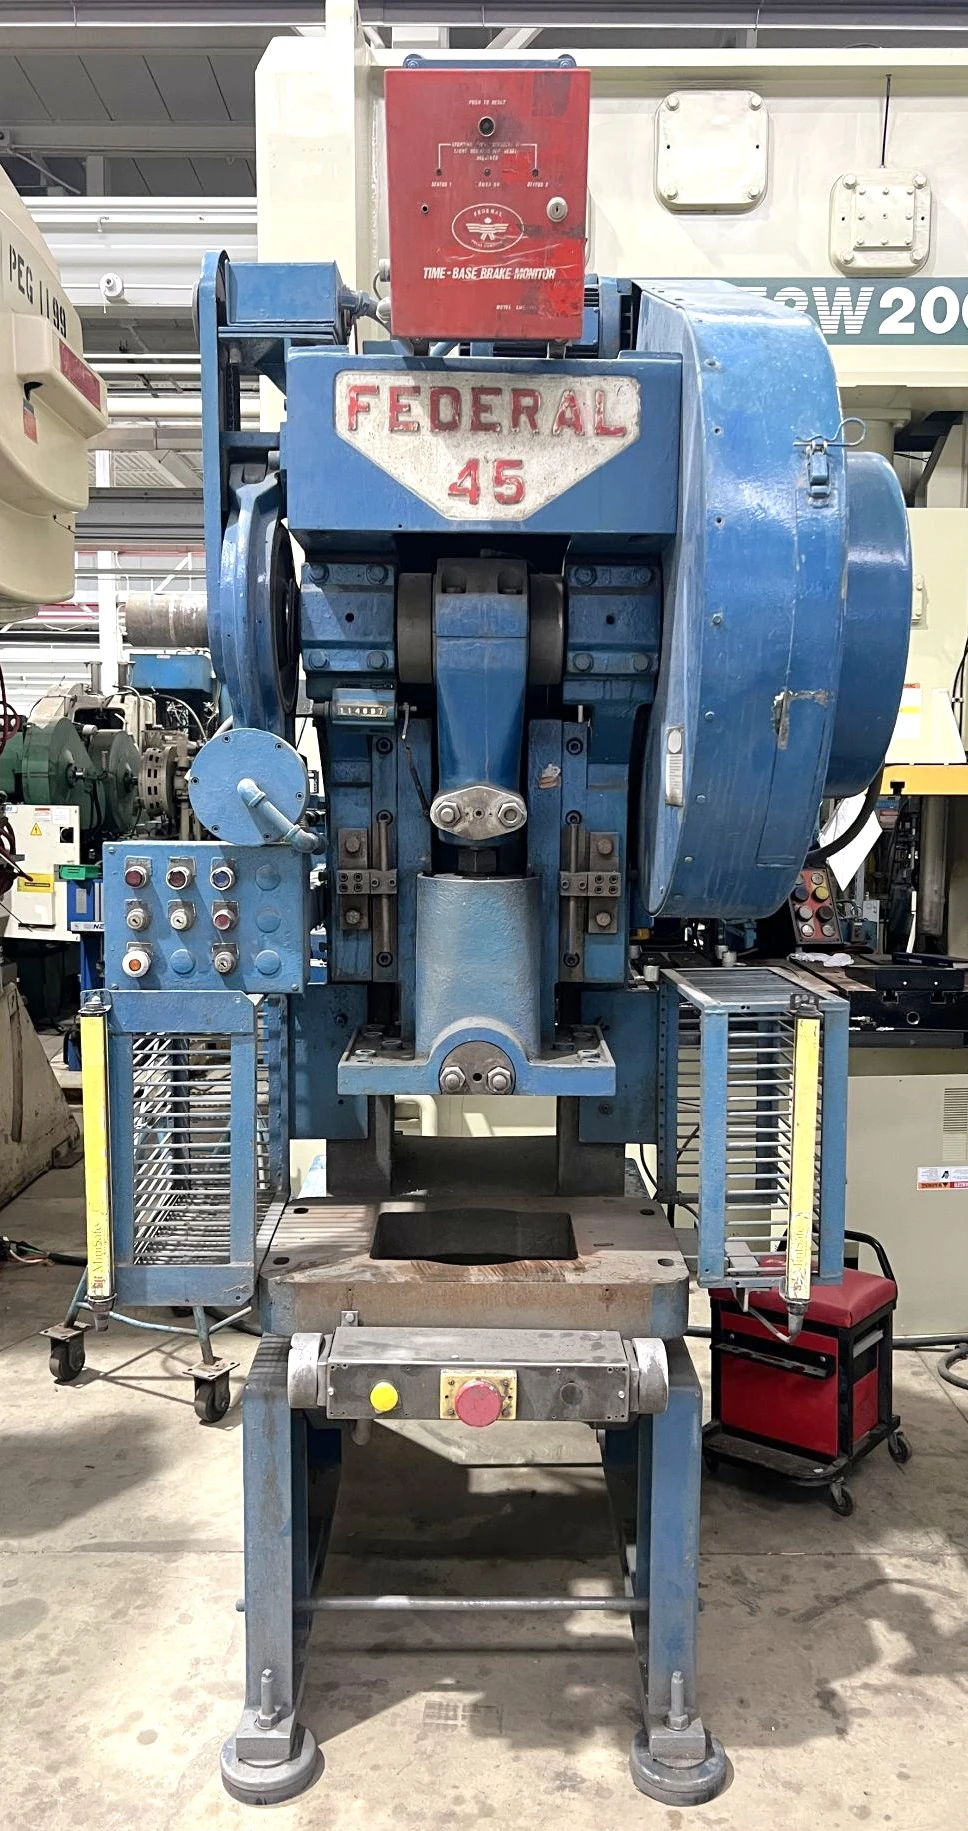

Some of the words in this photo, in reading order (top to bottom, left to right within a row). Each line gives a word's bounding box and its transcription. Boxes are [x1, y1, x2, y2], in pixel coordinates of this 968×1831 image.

[473, 208, 502, 217] FEDERAL
[9, 244, 33, 304] PEG
[40, 280, 66, 338] 1199
[480, 267, 511, 279] BRAKE
[514, 268, 556, 279] MONITOR
[346, 385, 627, 438] FEDERAL
[447, 458, 526, 506] 45
